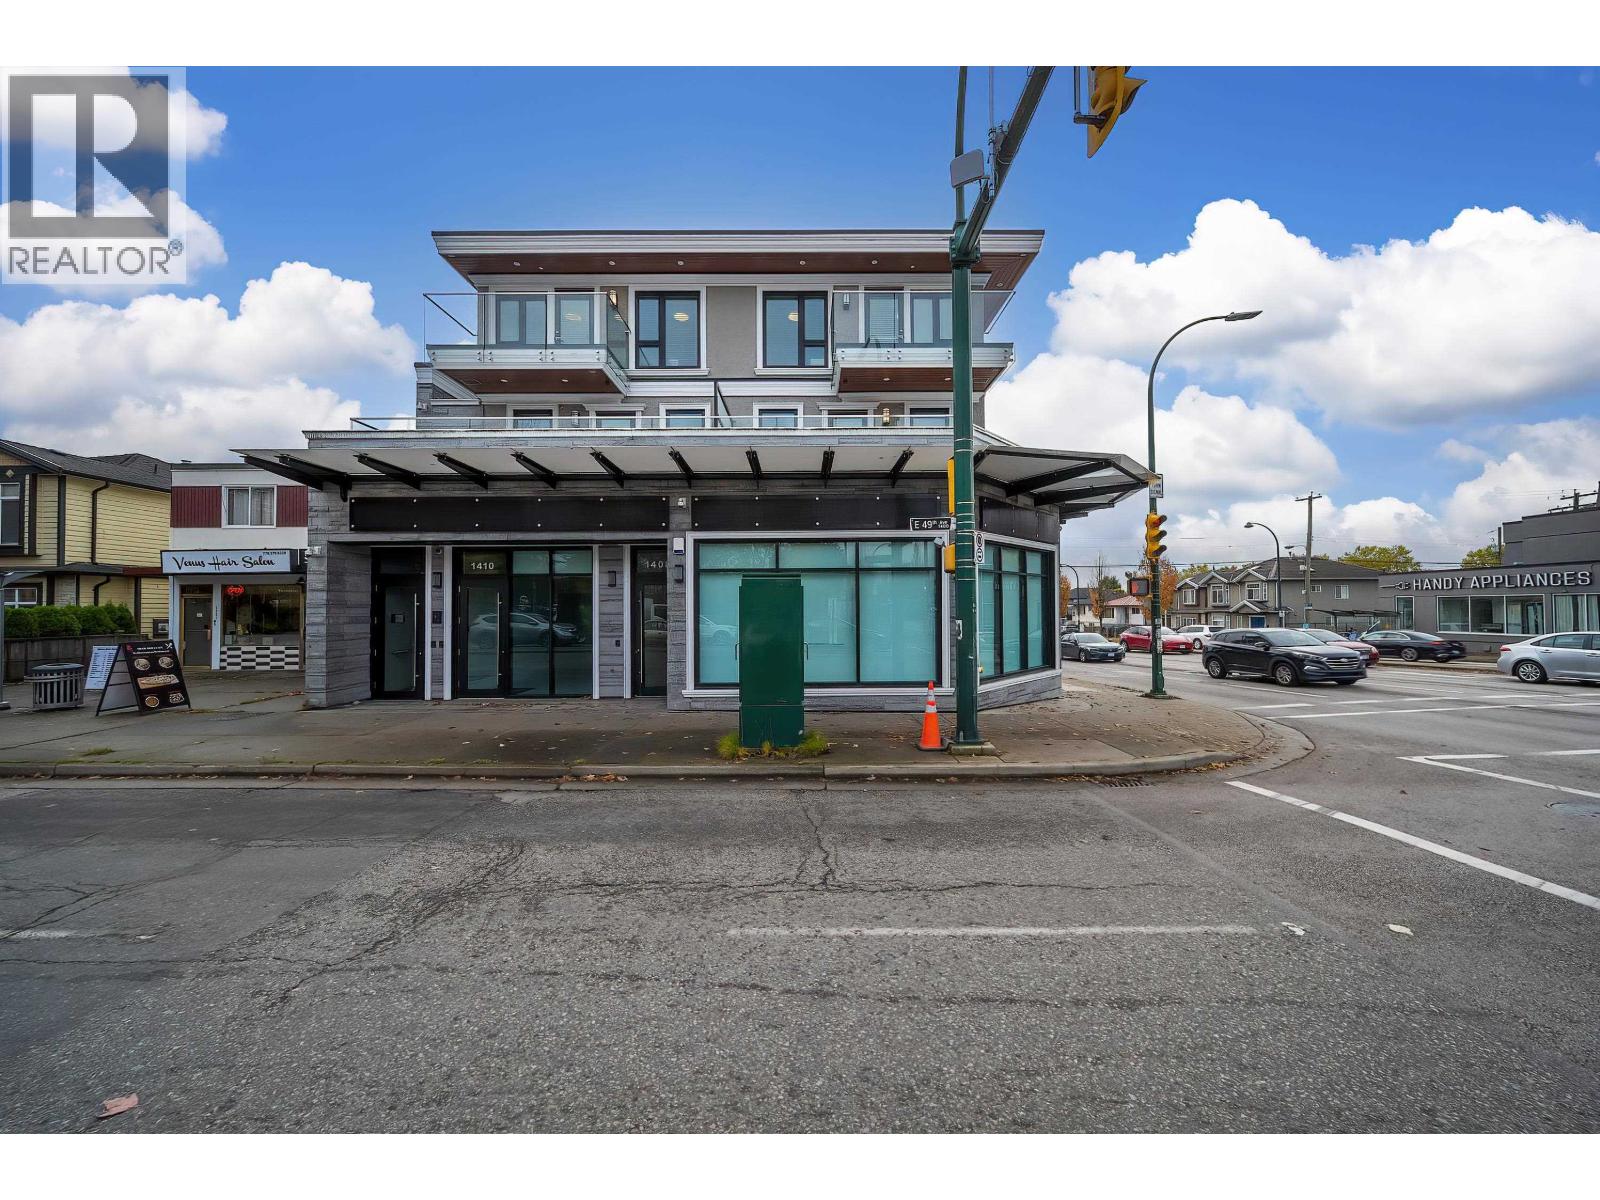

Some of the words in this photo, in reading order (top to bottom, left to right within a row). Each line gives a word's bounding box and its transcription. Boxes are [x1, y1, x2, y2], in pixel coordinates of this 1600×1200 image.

[914, 520, 920, 528] E
[922, 520, 938, 528] 49th
[172, 556, 206, 570] Venus
[208, 555, 239, 571] Hair
[242, 555, 275, 569] Salon
[1413, 576, 1464, 591] HANDY
[1470, 571, 1592, 589] APPLIANCES
